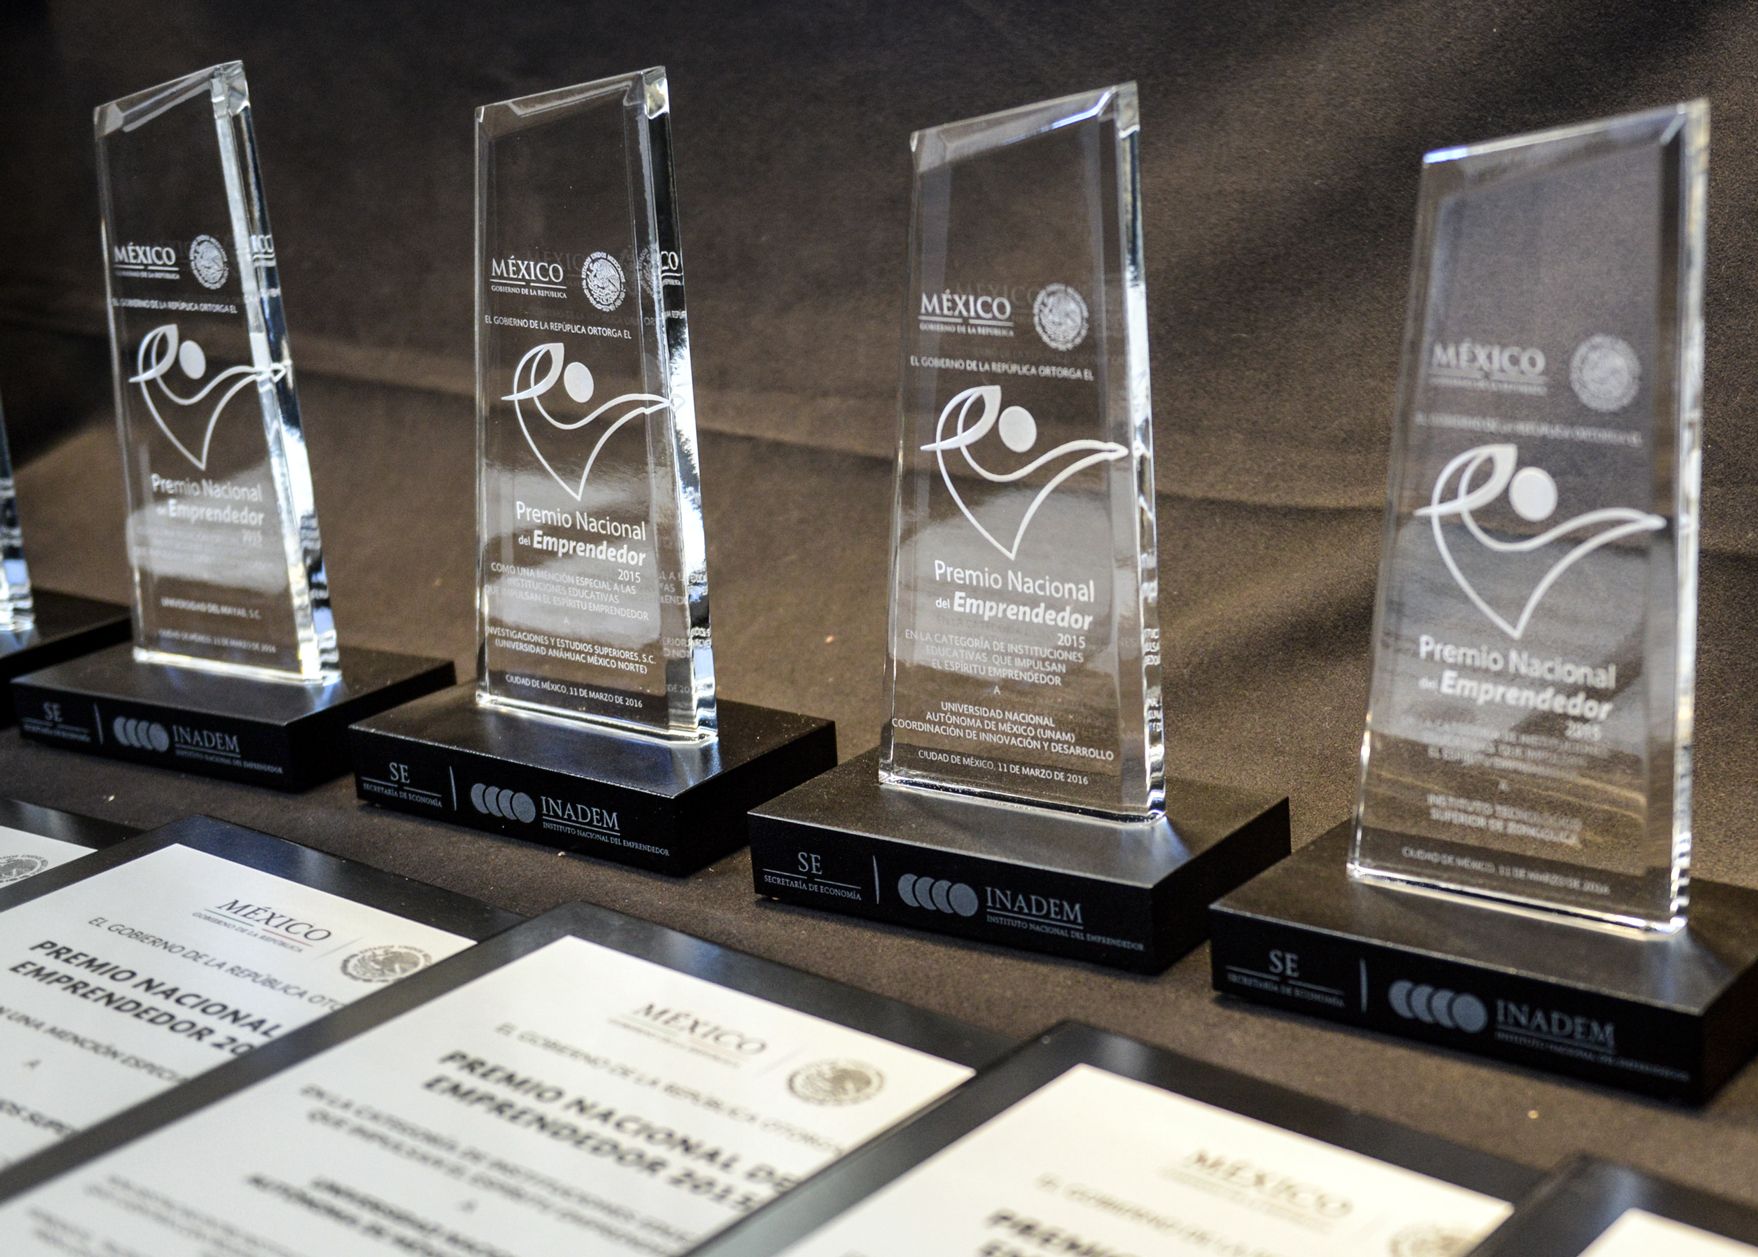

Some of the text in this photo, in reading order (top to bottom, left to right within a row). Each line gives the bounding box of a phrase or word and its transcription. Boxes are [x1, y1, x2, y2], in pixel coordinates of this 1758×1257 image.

[113, 242, 177, 265] MÉXICO
[491, 255, 564, 282] MÉXICO
[920, 288, 1011, 320] MÉXICO
[493, 316, 528, 328] GOBIERNO
[529, 320, 539, 330] DE
[540, 321, 549, 330] LA
[587, 326, 622, 338] ORTORGA
[624, 330, 632, 339] EL
[910, 355, 920, 366] EL
[921, 357, 964, 370] GOBIERNO
[966, 360, 977, 371] DE
[979, 361, 990, 371] LA
[1038, 365, 1082, 379] ORTORGA
[1084, 369, 1095, 381] EL
[1431, 338, 1546, 375] MÉXICO
[152, 474, 263, 502] Premio Nacional
[168, 499, 265, 527] Emprendedor
[516, 501, 647, 541] Premio Nacional
[519, 530, 647, 566] del Emprendedor
[490, 562, 515, 575] COMO
[517, 567, 535, 578] UNA
[576, 575, 611, 592] ESPECIAL
[613, 583, 620, 592] A
[621, 584, 636, 596] LAS
[618, 569, 641, 583] 2015
[935, 559, 1095, 602] Premio Nacional
[568, 587, 619, 604] EDUCATIVAS
[936, 591, 1094, 631] del Emprendedor
[564, 616, 569, 625] A
[588, 602, 649, 621] EMPRENDEDOR
[550, 637, 556, 646] Y
[556, 638, 593, 653] ESTUDIOS
[594, 645, 641, 662] SUPERIORES,
[642, 654, 657, 665] S.C.
[934, 632, 990, 650] CATEGORÍA
[993, 641, 1006, 652] DE
[1008, 643, 1083, 662] INSTITUCIONES
[1057, 633, 1086, 648] 2015
[495, 639, 648, 675] (UNIVERSIDAD ANÁHUAC MÉXICO NORTE)
[926, 646, 1065, 673] EDUCATIVAS QUE IMPULSAN
[932, 659, 942, 669] EL
[988, 667, 1062, 686] EMPRENDEDOR
[1419, 634, 1616, 690] Premio Nacional
[506, 673, 643, 709] CIUDAD DE MÉXICO, 11 DE MARZO DE 2016
[993, 685, 1001, 695] A
[1439, 670, 1613, 721] Emprendedor
[43, 702, 63, 722] SE
[926, 710, 1075, 744] AUTÓNOMA DE MÉXICO (UNAM)
[941, 701, 1055, 728] UNIVERSIDAD NACIONAL
[172, 724, 240, 752] INADEM
[892, 718, 1114, 761] COORDINACIÓN DE INNOVACIÓN Y DESARROLLO
[389, 762, 411, 784] SE
[918, 750, 1089, 785] CIUDAD DE MÉXICO, 11 DE MARZO DE 2016
[540, 796, 620, 830] INADEM
[542, 821, 670, 856] INSTITUTO NACIONAL DEL EMPRENDEDOR
[798, 852, 823, 875] SE
[764, 874, 862, 901] SECRETARÍA DE ECONOMÍA
[216, 899, 331, 941] MÉXICO
[985, 887, 1083, 924] INADEM
[986, 915, 1028, 930] INSTITUTO
[1029, 923, 1069, 938] NACIONAL
[1070, 931, 1085, 941] DEL
[88, 917, 309, 999] EL GOBIERNO DE LA REPÚBLICA
[1269, 949, 1299, 978] SE
[9, 960, 214, 1042] EMPRENDEDOR
[29, 939, 282, 1038] PREMIO NACIONAL
[1496, 999, 1615, 1049] INADEM
[422, 1074, 668, 1176] EMPRENDEDOR
[439, 1049, 565, 1105] PREMIO
[564, 1096, 741, 1173] NACIONAL
